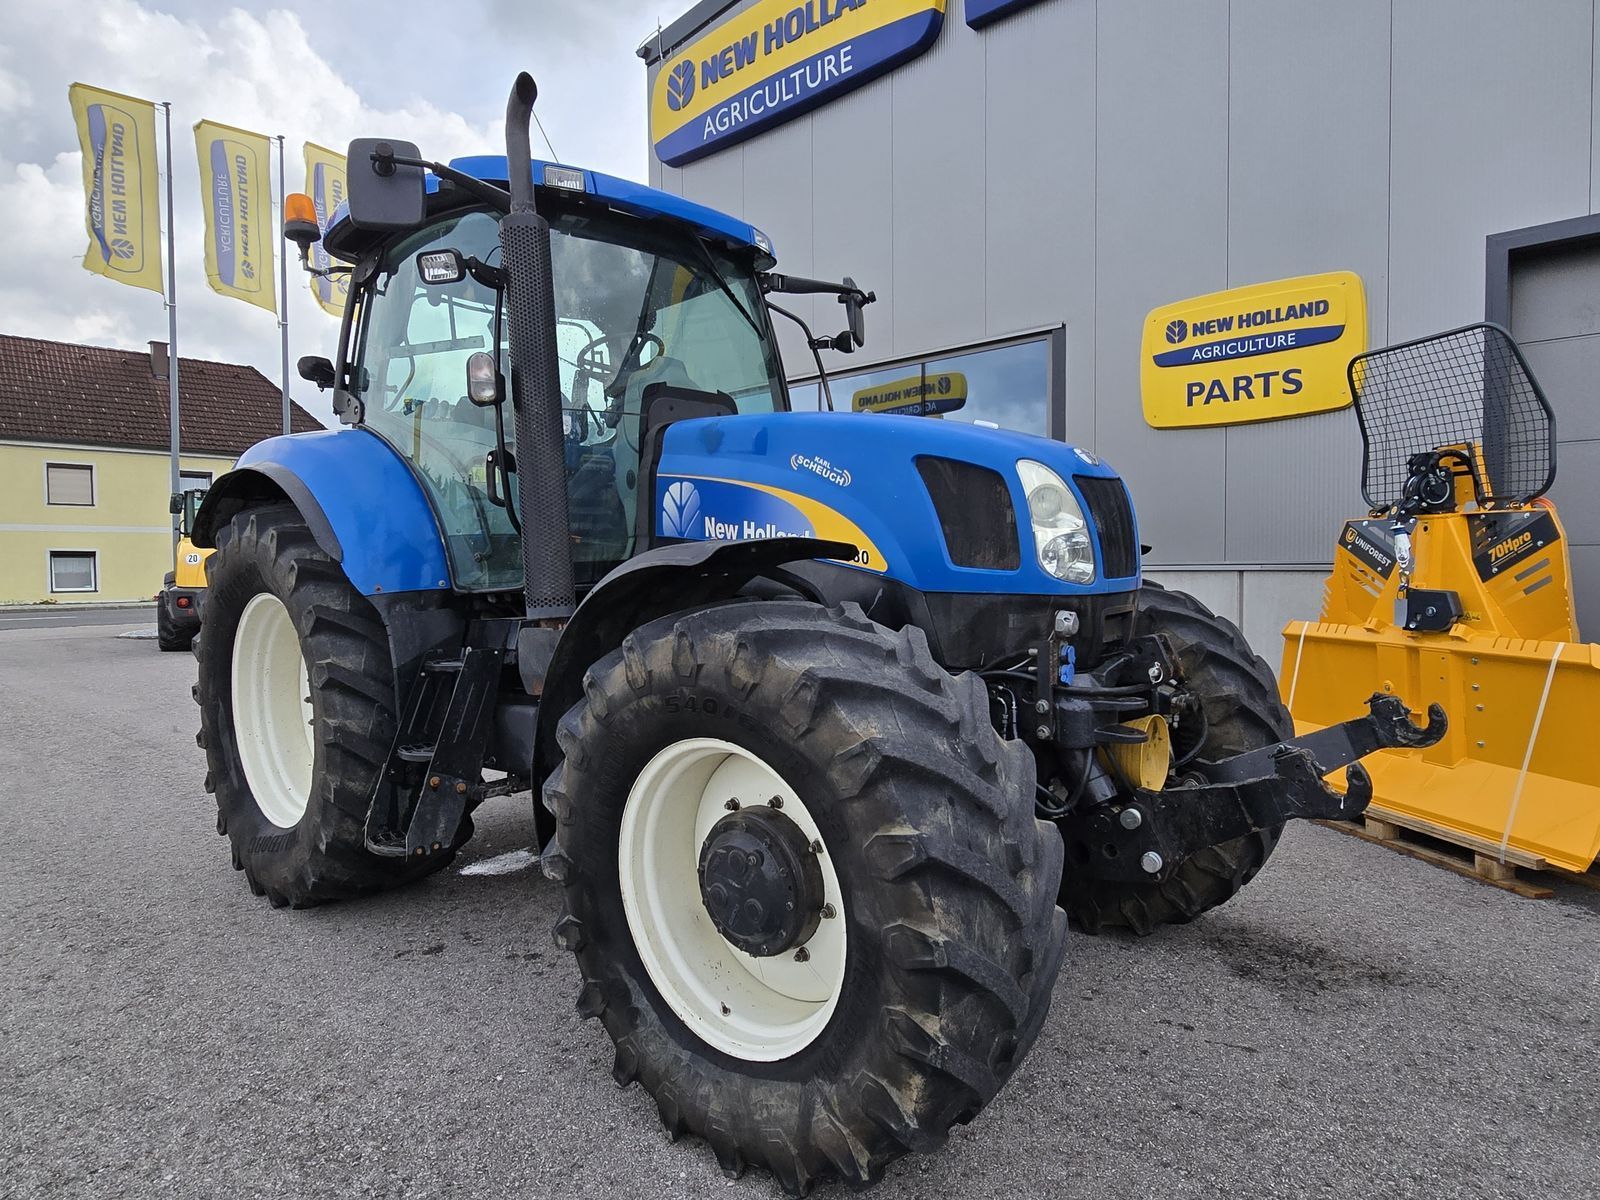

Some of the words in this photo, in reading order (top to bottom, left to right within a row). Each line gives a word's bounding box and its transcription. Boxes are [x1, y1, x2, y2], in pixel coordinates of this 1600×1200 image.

[701, 31, 758, 90] NEW
[702, 45, 854, 140] AGRICULTURE
[1192, 315, 1234, 337] NEW
[1237, 299, 1330, 329] HOLLAND
[1191, 333, 1296, 361] AGRICULTURE
[1186, 368, 1304, 407] PARTS
[796, 455, 845, 486] SCHEUCH
[814, 456, 831, 469] KARL
[704, 516, 739, 540] New
[188, 554, 198, 563] 20
[1355, 536, 1392, 567] UNIFOREST
[1487, 531, 1532, 562] 70Hpro
